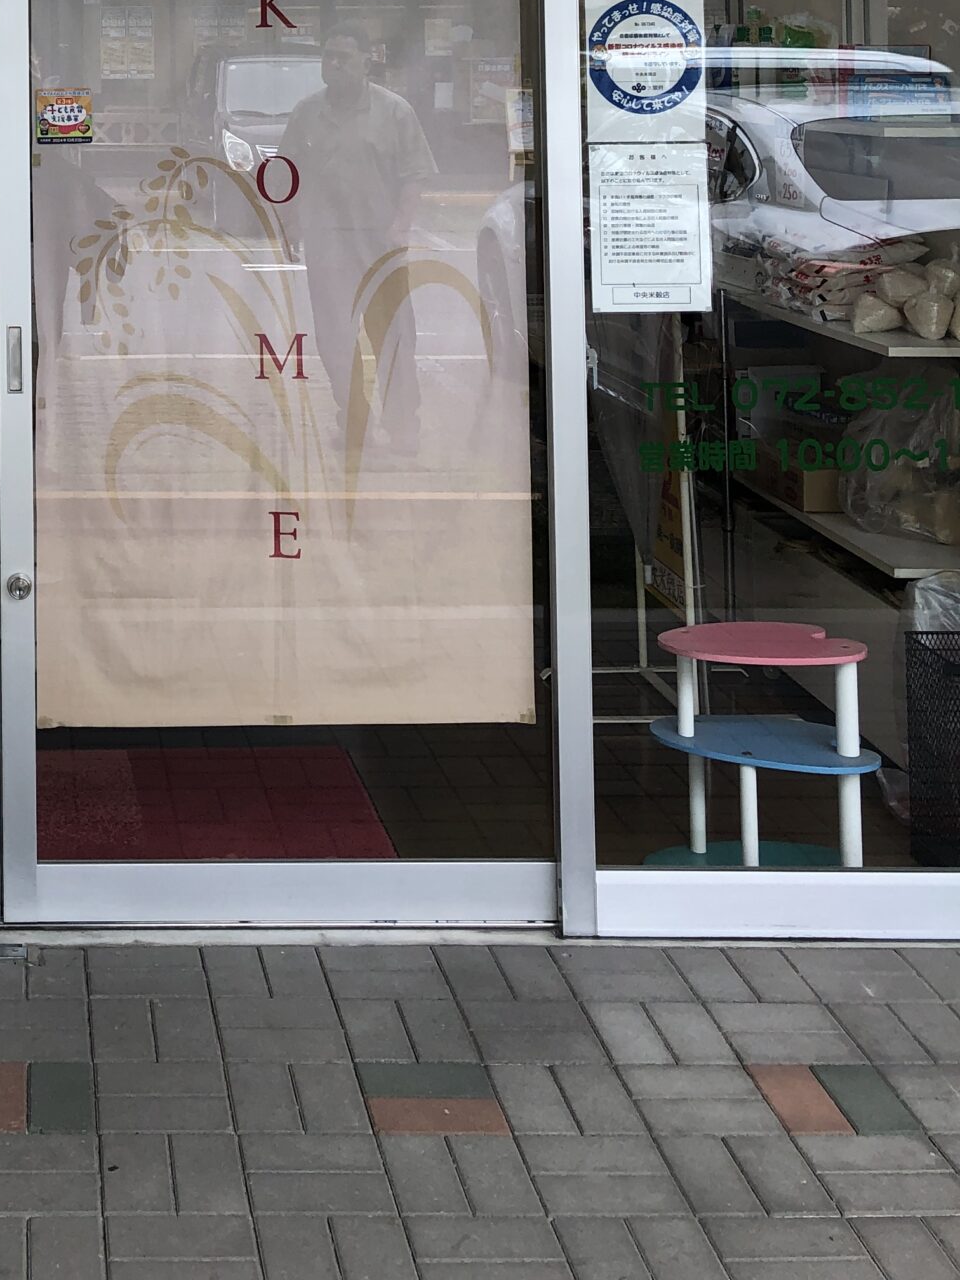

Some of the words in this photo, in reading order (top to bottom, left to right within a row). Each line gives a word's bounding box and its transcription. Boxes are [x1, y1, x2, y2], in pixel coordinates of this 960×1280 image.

[642, 382, 716, 412] TEL
[640, 440, 757, 472] 営業時間
